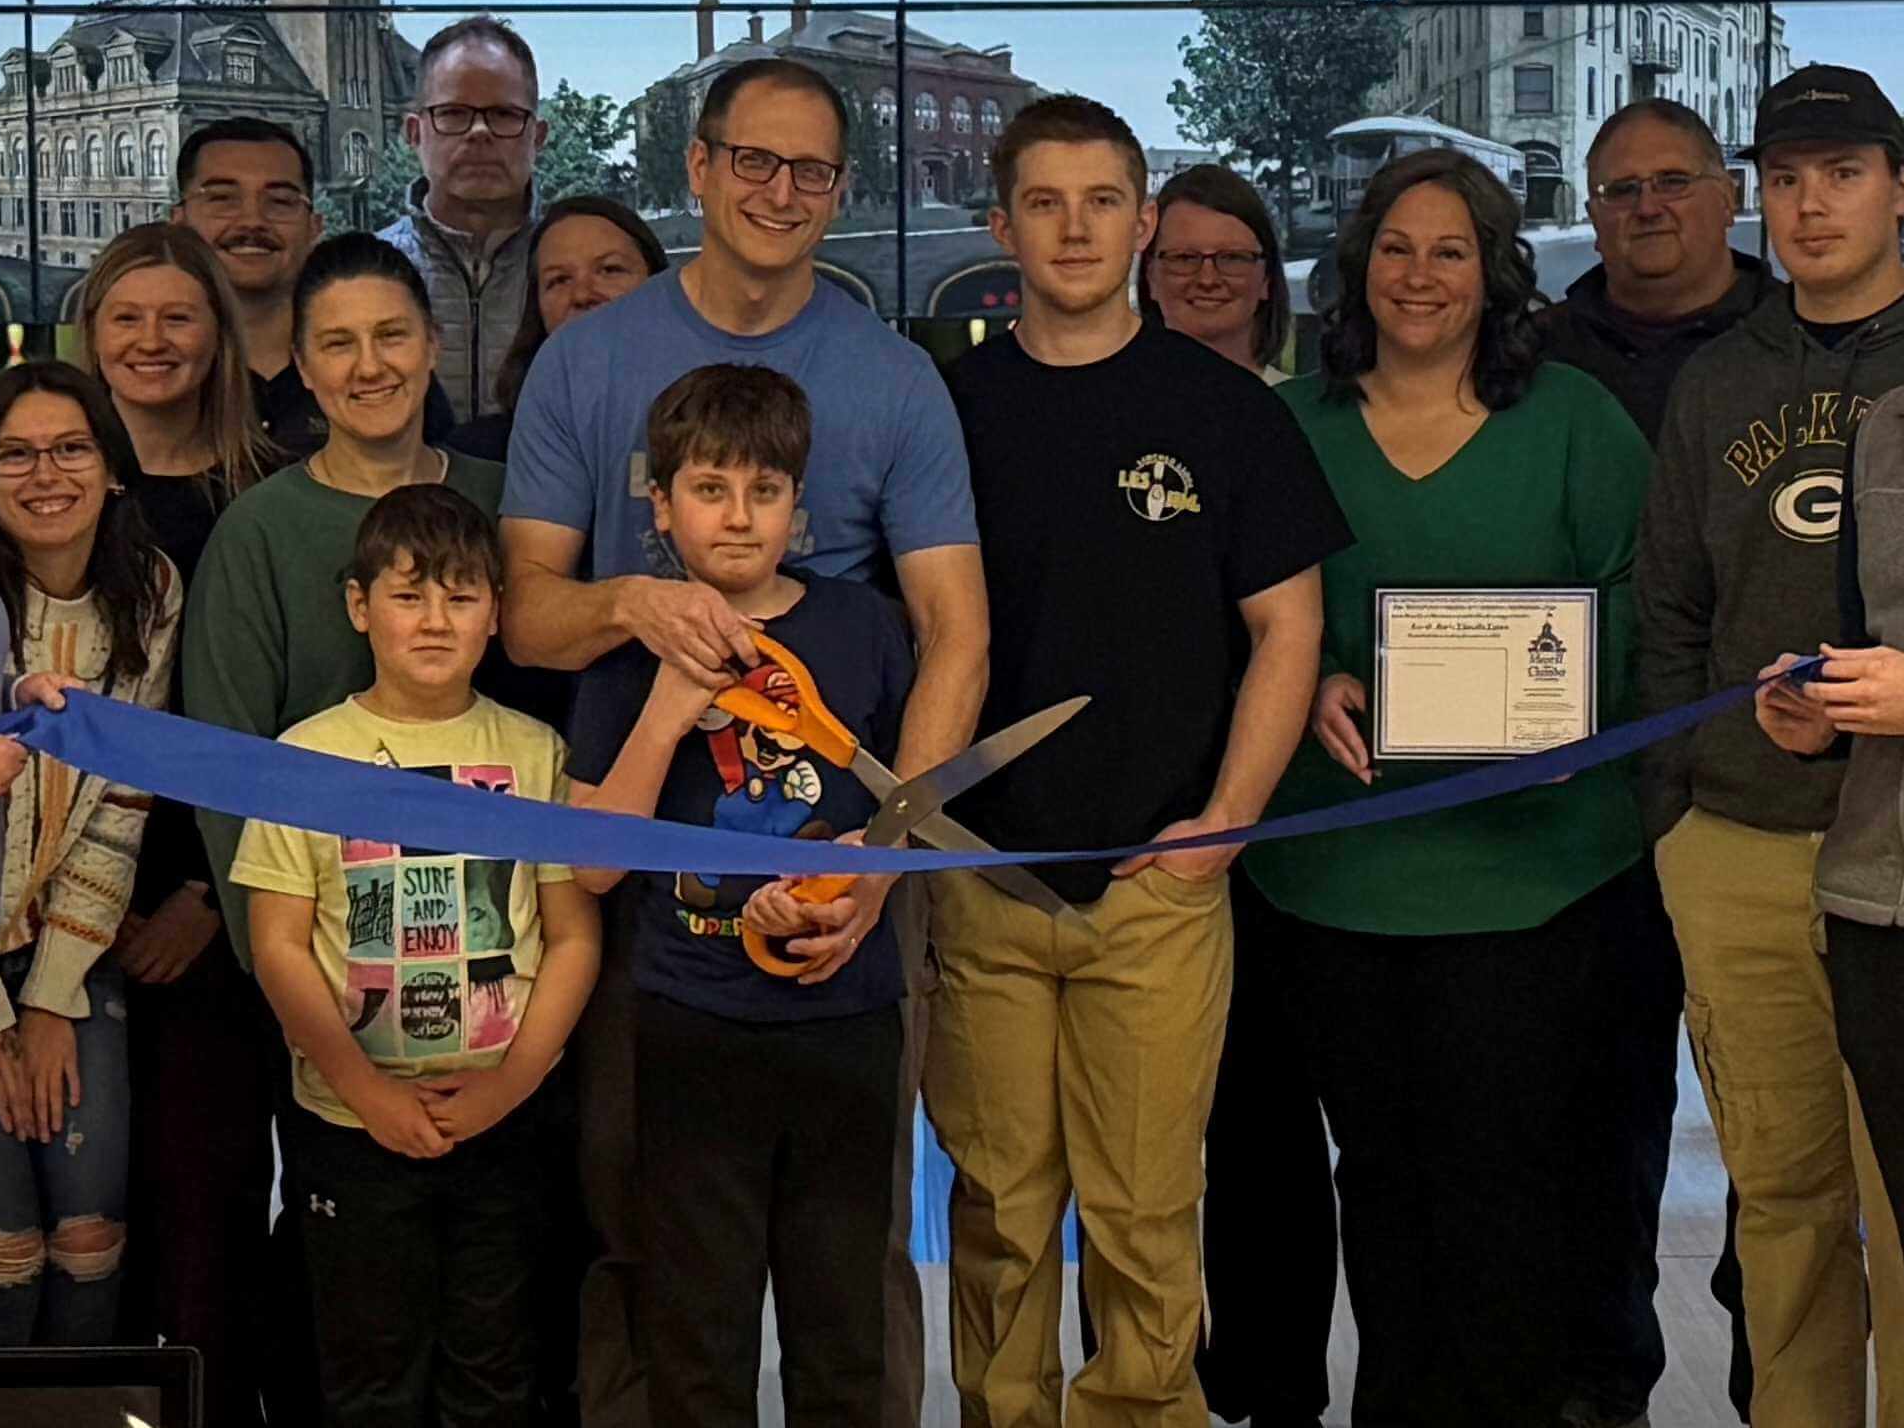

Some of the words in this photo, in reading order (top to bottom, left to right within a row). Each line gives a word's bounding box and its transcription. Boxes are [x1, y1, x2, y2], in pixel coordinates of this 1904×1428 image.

[1773, 473, 1843, 538] G
[403, 866, 456, 897] SURF
[403, 924, 460, 953] ENJOY
